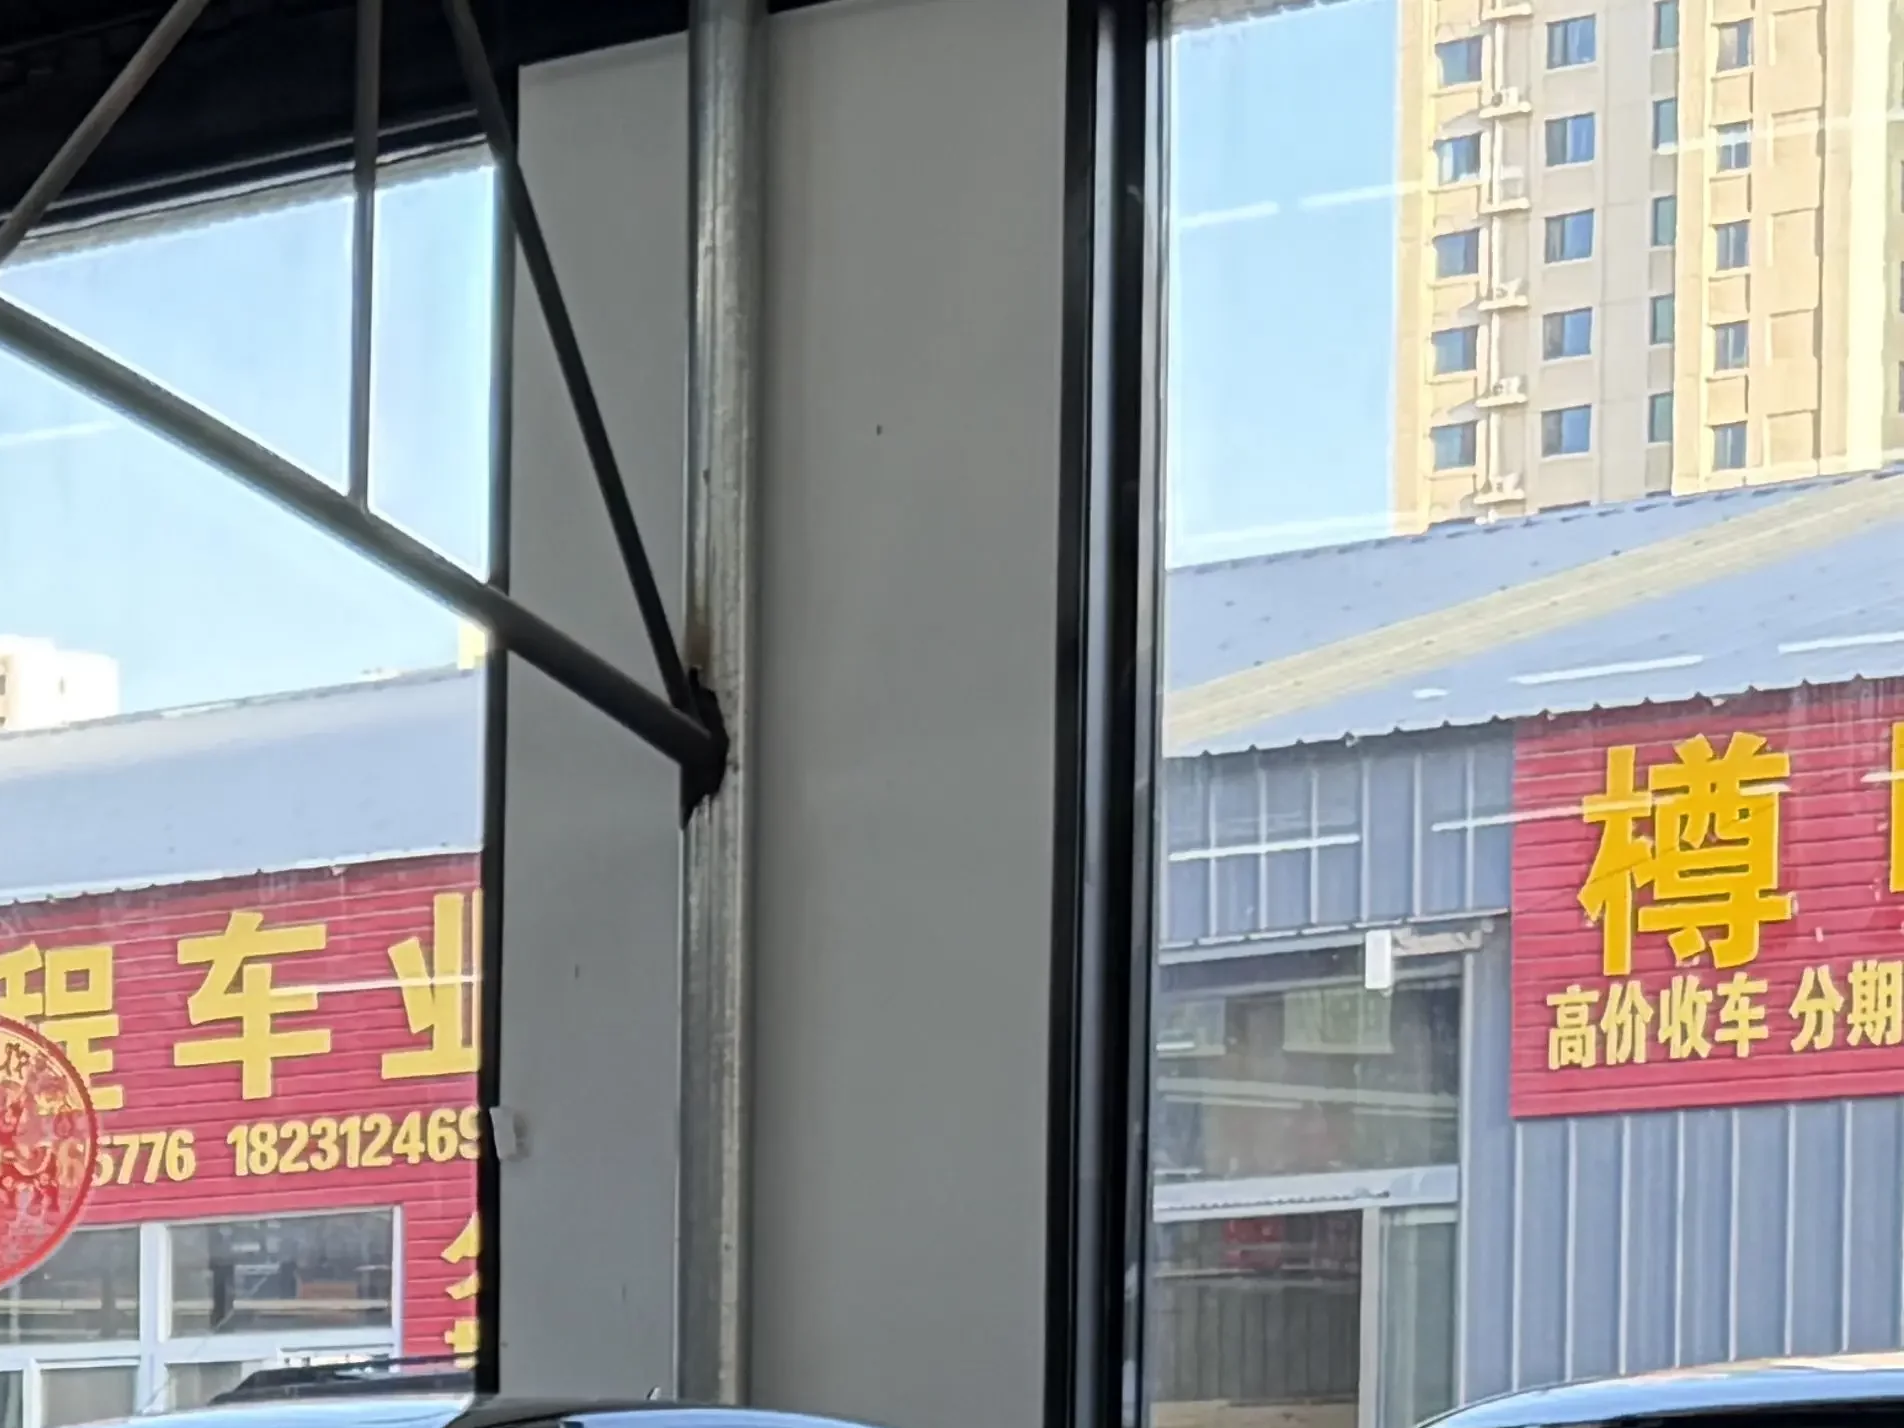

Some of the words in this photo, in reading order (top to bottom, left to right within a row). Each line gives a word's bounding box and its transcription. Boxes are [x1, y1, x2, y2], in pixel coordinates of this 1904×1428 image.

[1577, 722, 1904, 976] 樽
[1546, 971, 1770, 1070] 高价收车
[1789, 959, 1904, 1053] 分期
